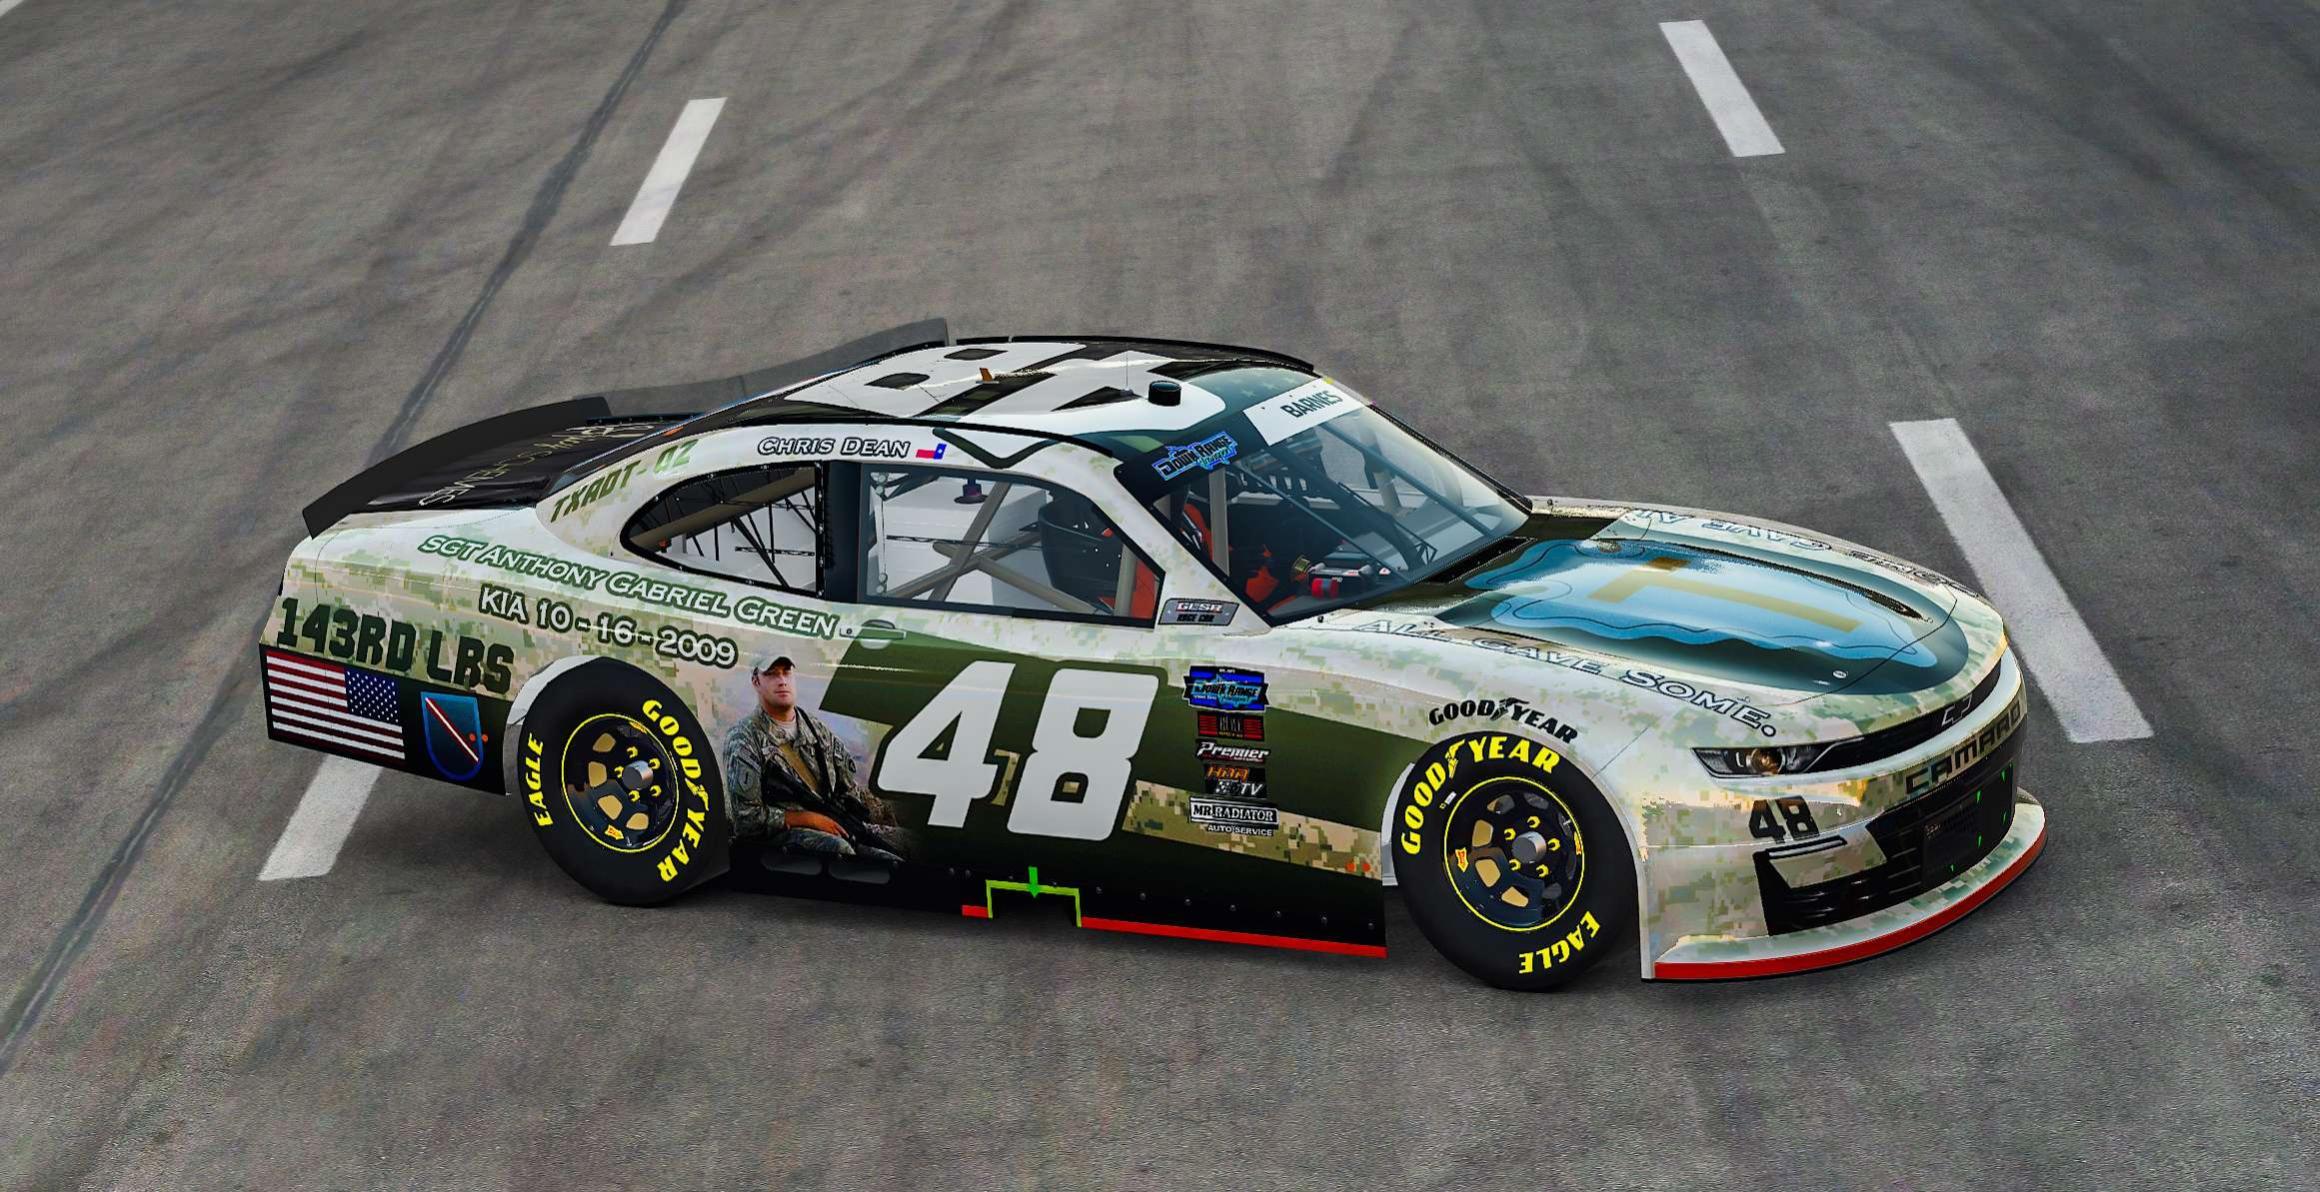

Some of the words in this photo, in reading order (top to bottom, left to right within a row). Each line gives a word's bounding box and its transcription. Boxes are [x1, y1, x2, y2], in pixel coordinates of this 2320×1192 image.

[1280, 390, 1344, 419] BARNES
[757, 436, 836, 456] CHRIS
[840, 437, 912, 458] DEAN
[419, 535, 488, 562] SGT
[478, 544, 608, 590] ANTHONY
[607, 572, 732, 618] GABRIEL
[734, 597, 841, 639] GREEN
[479, 585, 528, 623] KIA
[276, 597, 417, 673] 143RD
[426, 627, 516, 696] LBS
[1351, 618, 1450, 643] ALL
[1474, 636, 1606, 676] GAVE
[1620, 667, 1778, 738] SOME.
[1429, 697, 1579, 744] GOODYEAR
[1905, 699, 2022, 796] CAMARO
[876, 660, 1160, 841] 48
[1196, 741, 1270, 759] Premier
[526, 732, 554, 828] EAGLE
[641, 698, 711, 884] GOODYEAR
[1240, 782, 1264, 796] TV
[1400, 735, 1562, 856] GOODYEAR
[1207, 823, 1232, 833] AUTO
[1234, 826, 1273, 837] SERVICE
[1214, 806, 1274, 821] RADIATOR
[1748, 795, 1820, 844] 48
[1518, 910, 1601, 974] EAGLE
